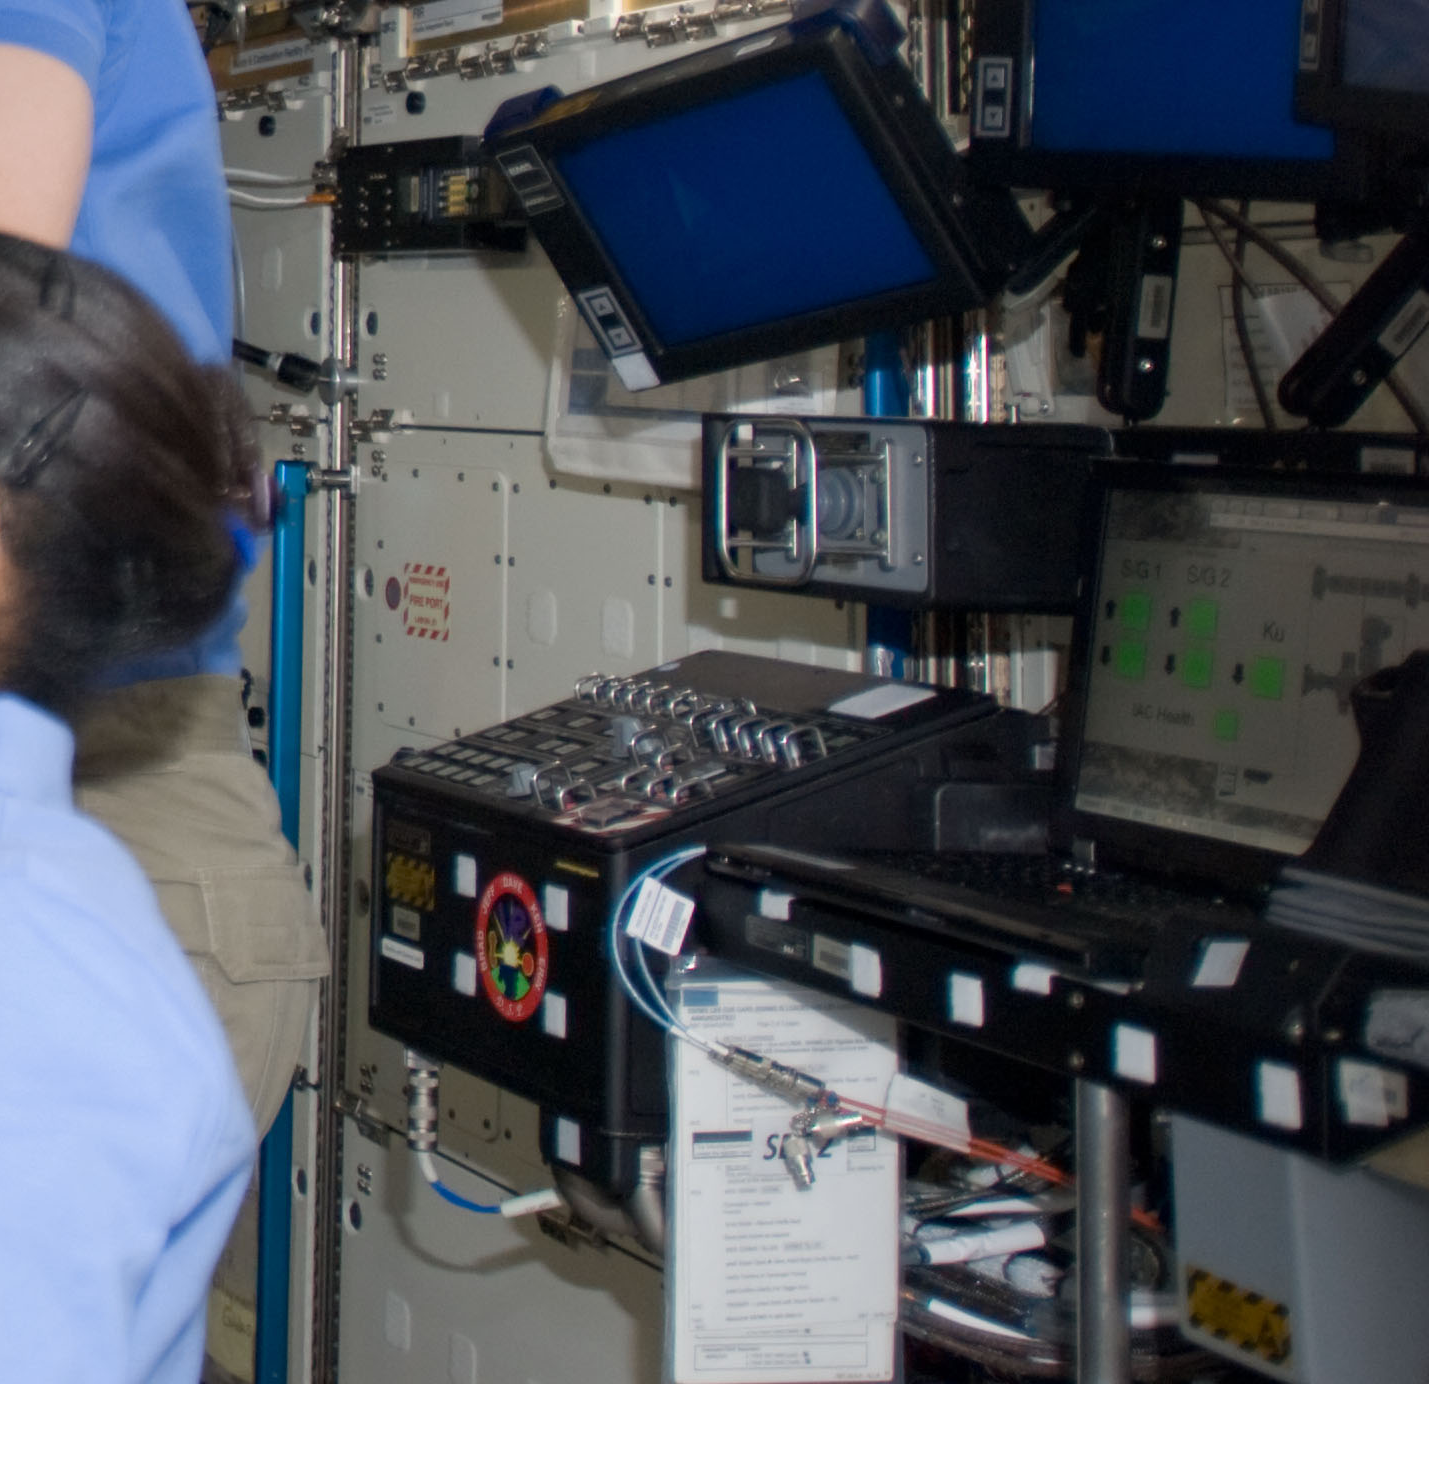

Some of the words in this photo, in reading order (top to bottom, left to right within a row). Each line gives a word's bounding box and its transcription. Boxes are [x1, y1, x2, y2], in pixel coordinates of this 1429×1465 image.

[425, 597, 443, 609] PORT
[1262, 620, 1286, 643] Ku
[502, 876, 524, 895] DAVE
